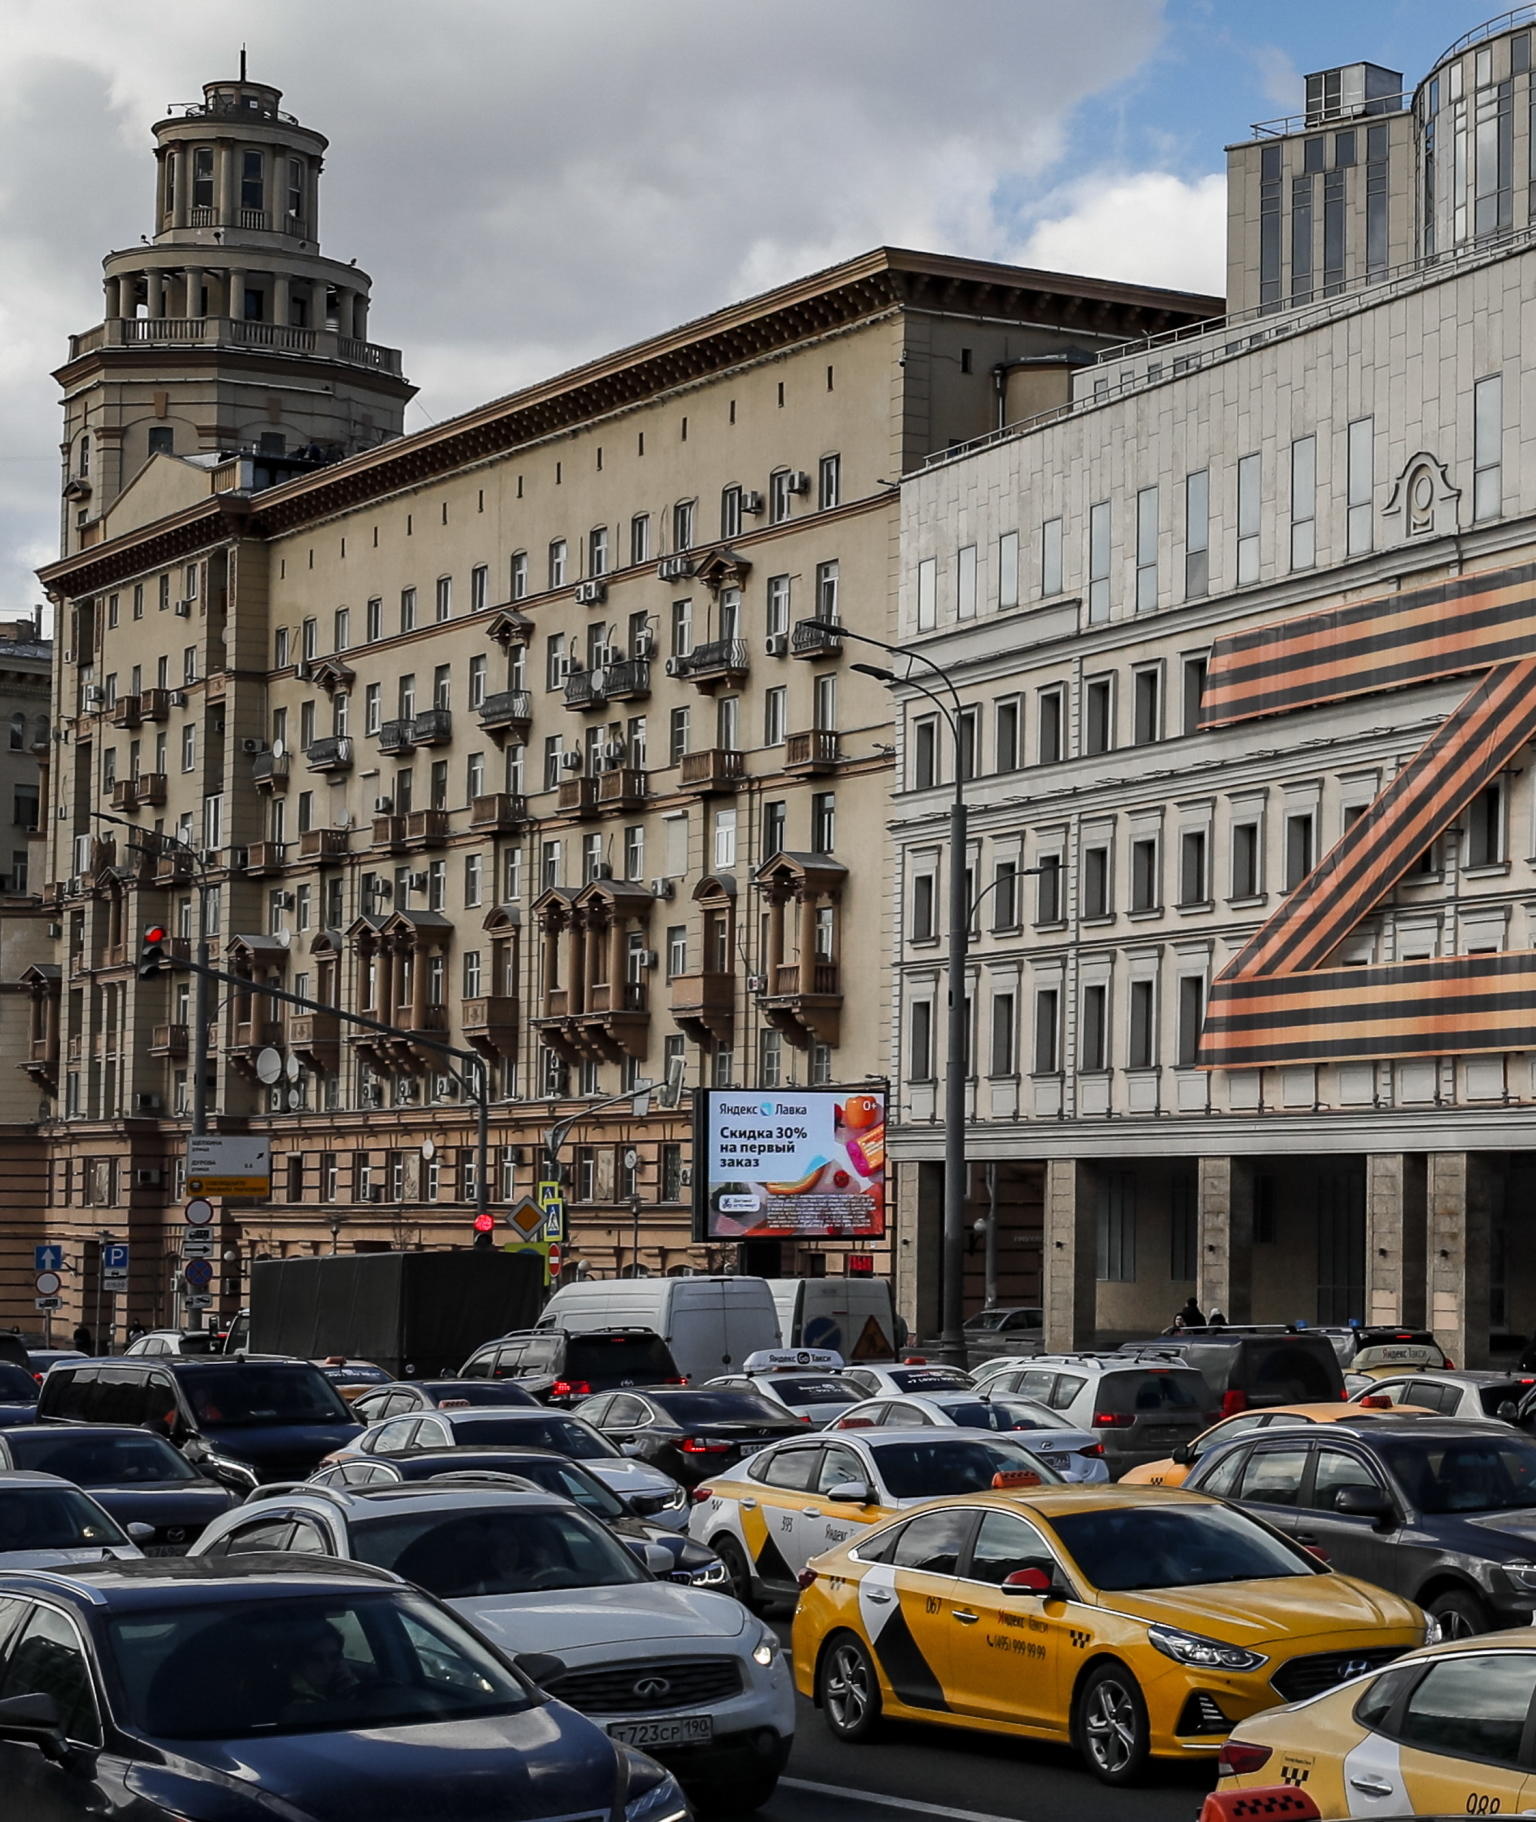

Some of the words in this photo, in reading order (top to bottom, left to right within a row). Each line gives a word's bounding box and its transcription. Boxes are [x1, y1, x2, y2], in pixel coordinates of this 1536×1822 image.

[719, 1103, 758, 1116] Яндекс
[775, 1103, 807, 1115] Лавка
[863, 1100, 877, 1111] 0+
[720, 1127, 773, 1141] Скидка
[776, 1126, 807, 1139] 30%
[720, 1144, 737, 1153] на
[739, 1141, 795, 1156] первый
[720, 1157, 760, 1168] заказ
[1382, 1347, 1407, 1360] Яндекс
[926, 1596, 942, 1615] 067
[684, 1718, 709, 1734] 190
